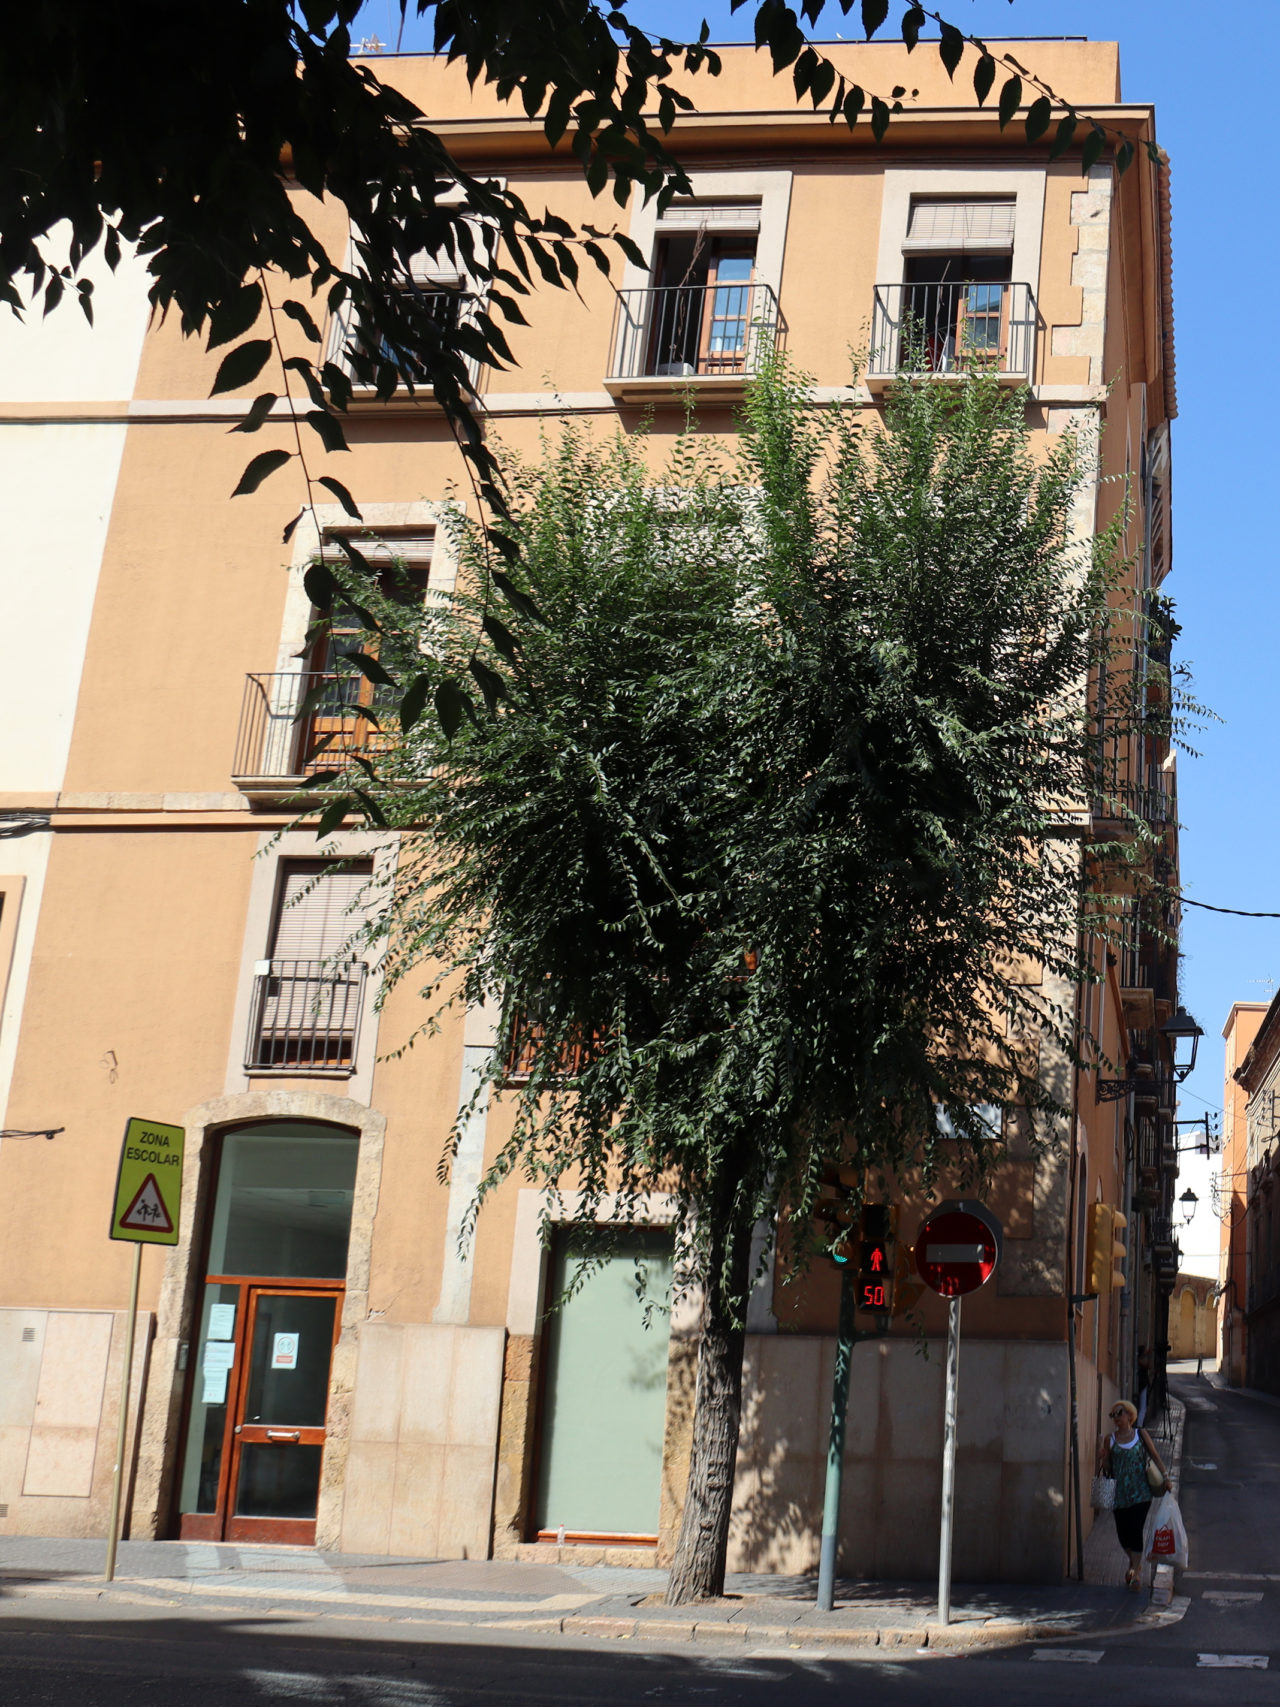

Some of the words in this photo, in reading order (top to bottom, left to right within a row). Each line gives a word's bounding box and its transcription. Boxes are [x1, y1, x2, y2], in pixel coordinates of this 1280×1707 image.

[139, 1131, 170, 1147] ZONA
[127, 1147, 180, 1167] ESCOLAR
[864, 1285, 885, 1306] 50
